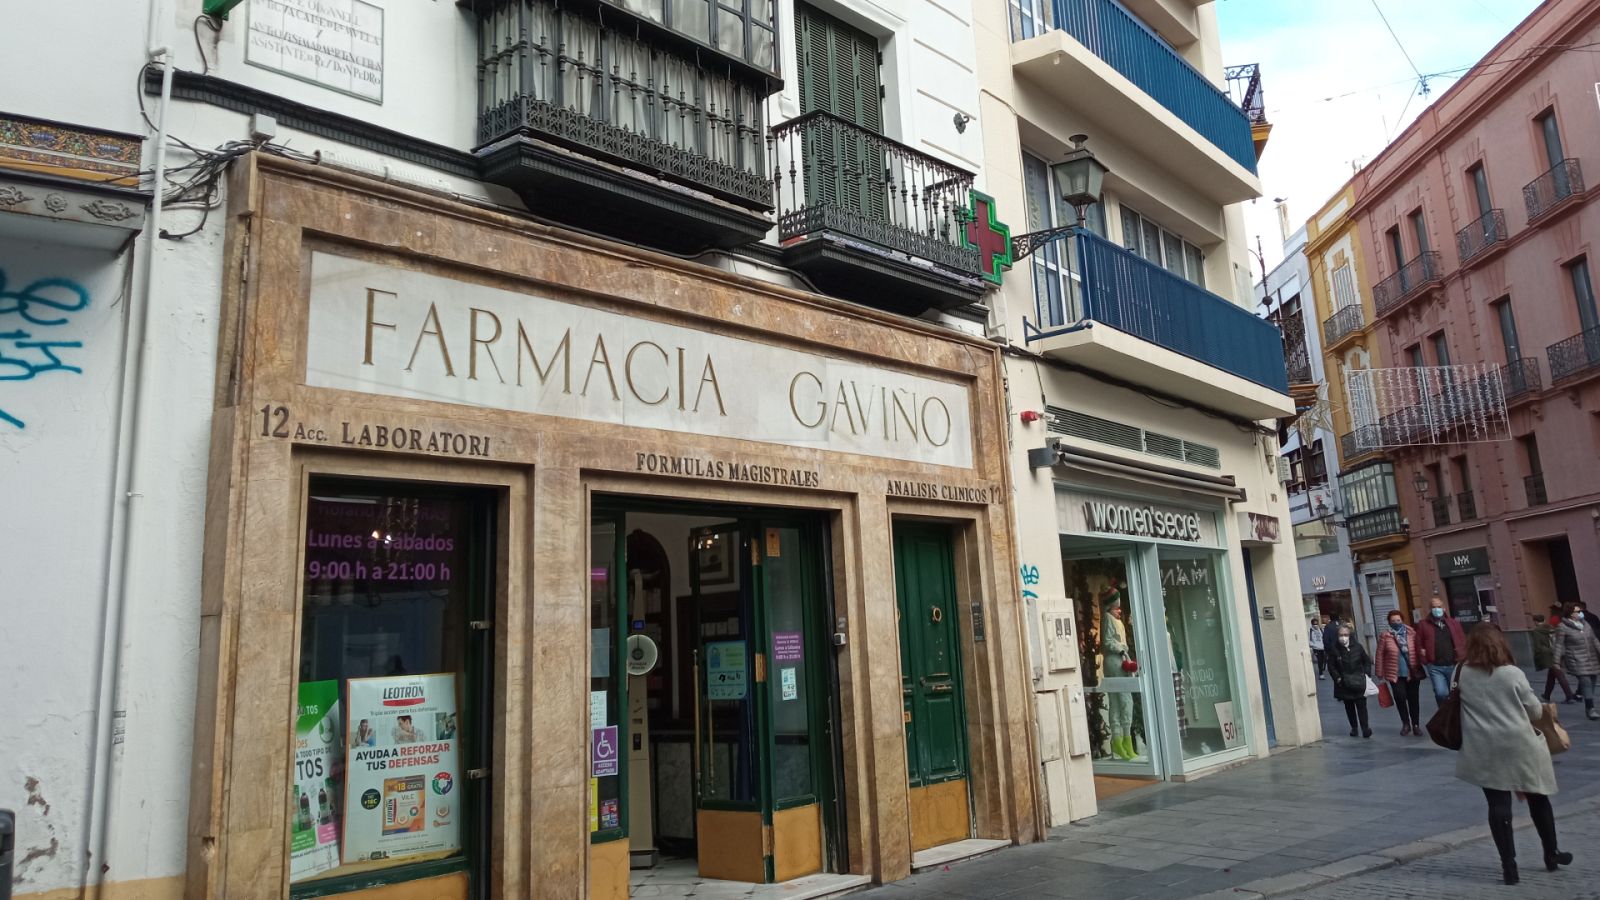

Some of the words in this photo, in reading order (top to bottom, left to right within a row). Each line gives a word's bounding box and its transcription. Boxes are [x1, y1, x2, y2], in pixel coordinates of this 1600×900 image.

[362, 286, 728, 418] FARMACIA
[788, 371, 952, 447] GAVIÑO
[260, 404, 290, 438] 12
[340, 422, 491, 457] LABORATORI
[636, 452, 725, 479] FORMULAS
[728, 461, 819, 488] MAGISTRALES
[886, 479, 938, 498] ANALISIS
[941, 485, 987, 503] CLINICOS
[1085, 501, 1201, 541] women'secret
[308, 529, 362, 549] Lunes
[309, 561, 350, 580] 9:00
[356, 560, 367, 580] h
[371, 565, 383, 580] a
[387, 561, 436, 580] 21:00
[440, 562, 451, 581] h
[383, 686, 425, 699] LEOTRON
[356, 749, 390, 761] AYUDA
[391, 748, 399, 758] A
[400, 743, 450, 756] REFORZAR
[366, 760, 386, 771] TUS
[388, 755, 440, 769] DEFENSAS
